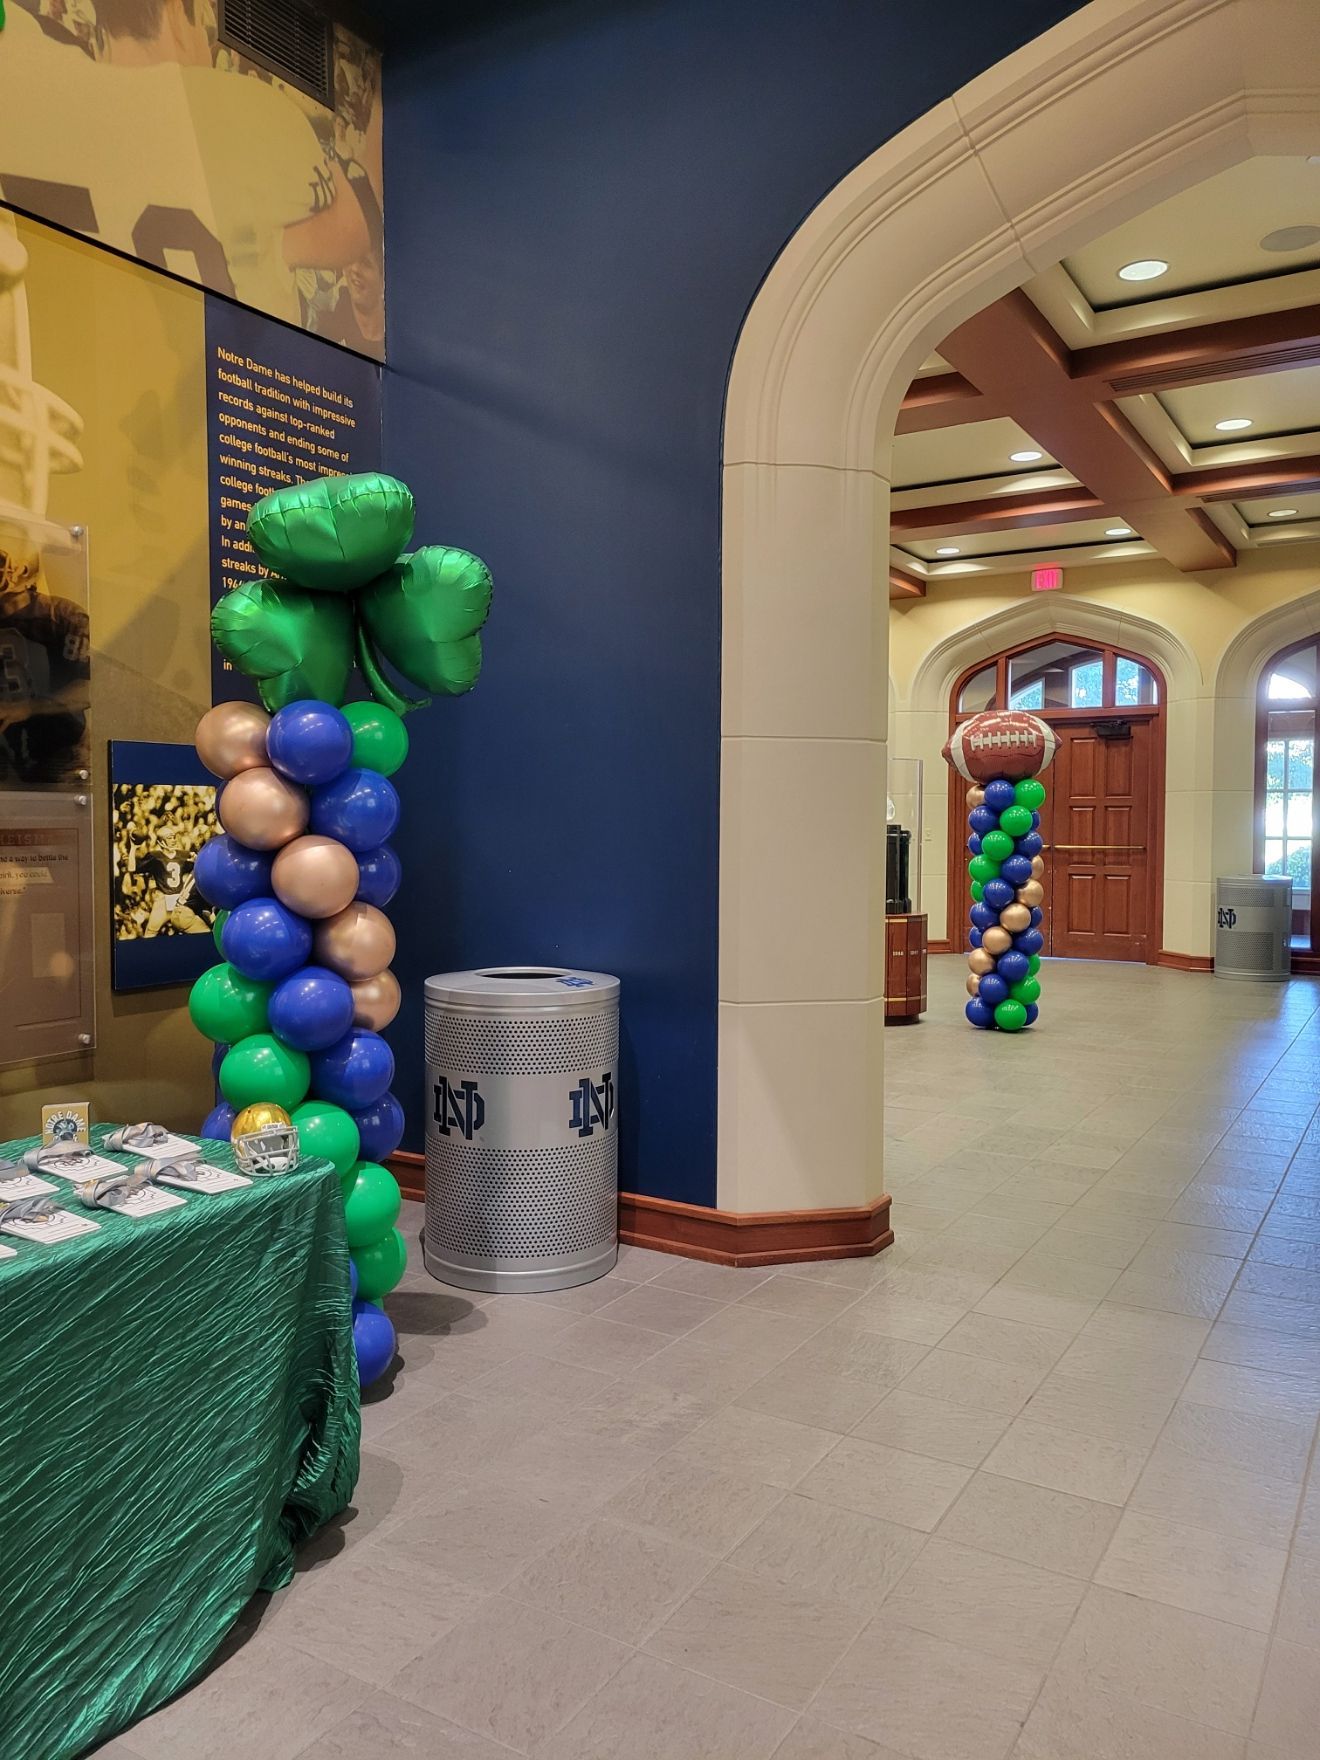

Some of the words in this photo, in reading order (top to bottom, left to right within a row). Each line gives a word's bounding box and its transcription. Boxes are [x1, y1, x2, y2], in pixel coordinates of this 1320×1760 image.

[217, 346, 244, 367] Notre
[246, 357, 273, 378] Dame
[275, 368, 291, 385] has
[292, 376, 321, 396] helped
[322, 387, 342, 404] build
[343, 395, 354, 409] its
[218, 368, 253, 391] football
[254, 382, 291, 405] tradition
[292, 397, 311, 412] with
[312, 402, 356, 428] impressive
[218, 391, 254, 411] records
[256, 405, 288, 423] against
[290, 414, 335, 439] top-ranked
[218, 412, 267, 436] opponents
[268, 428, 286, 443] and
[287, 435, 316, 455] ending
[317, 445, 340, 460] some
[341, 453, 350, 463] of
[219, 433, 252, 452] college
[254, 442, 294, 464] football's
[295, 457, 317, 473] most
[219, 454, 257, 476] winning
[258, 465, 294, 484] streaks.
[295, 473, 311, 487] Th
[219, 475, 253, 493] college
[220, 496, 252, 512] games
[221, 514, 232, 530] by
[221, 535, 230, 548] In
[221, 558, 257, 574] streaks
[258, 563, 269, 579] by
[1035, 570, 1058, 590] EXIT
[223, 658, 233, 671] in
[166, 861, 181, 888] 3
[433, 1075, 485, 1140] ND
